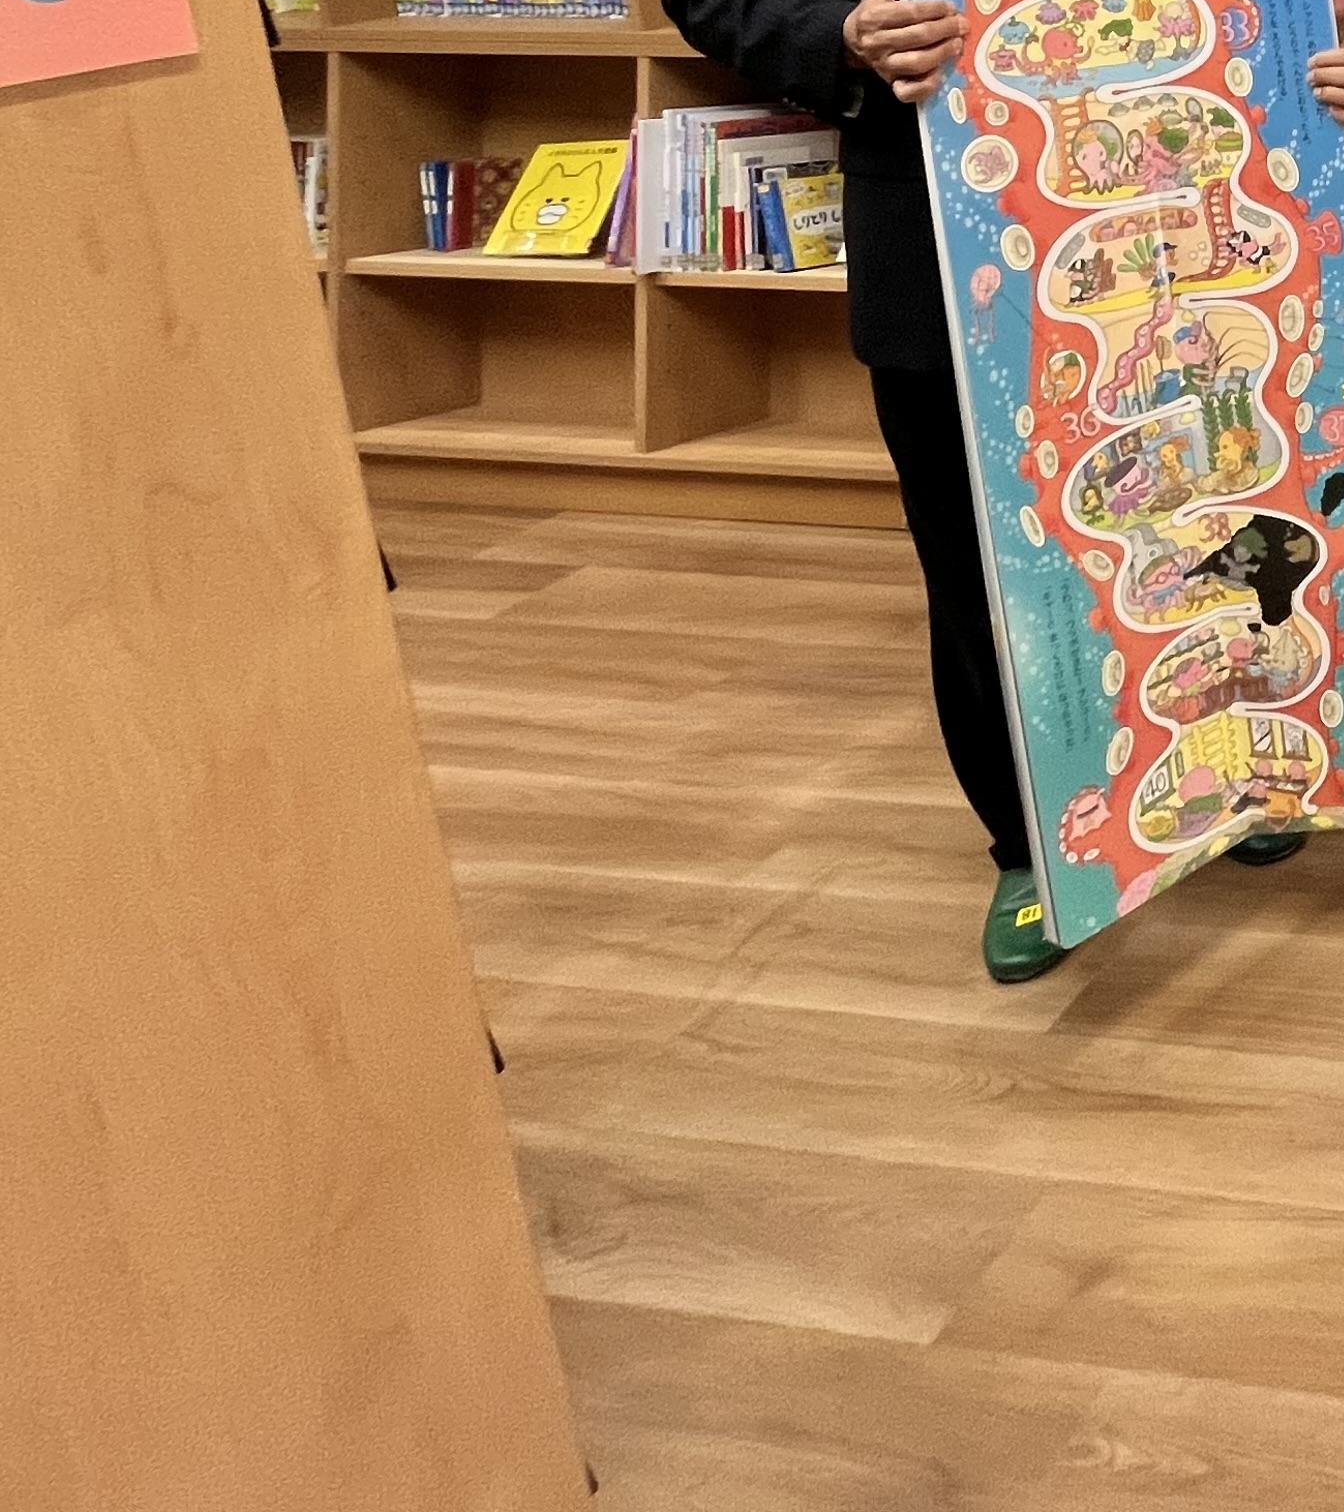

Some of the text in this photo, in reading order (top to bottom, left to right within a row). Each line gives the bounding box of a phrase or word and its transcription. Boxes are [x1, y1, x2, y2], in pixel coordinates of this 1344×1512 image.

[1307, 218, 1341, 249] 35
[1061, 410, 1103, 444] 36
[1197, 513, 1232, 543] 38
